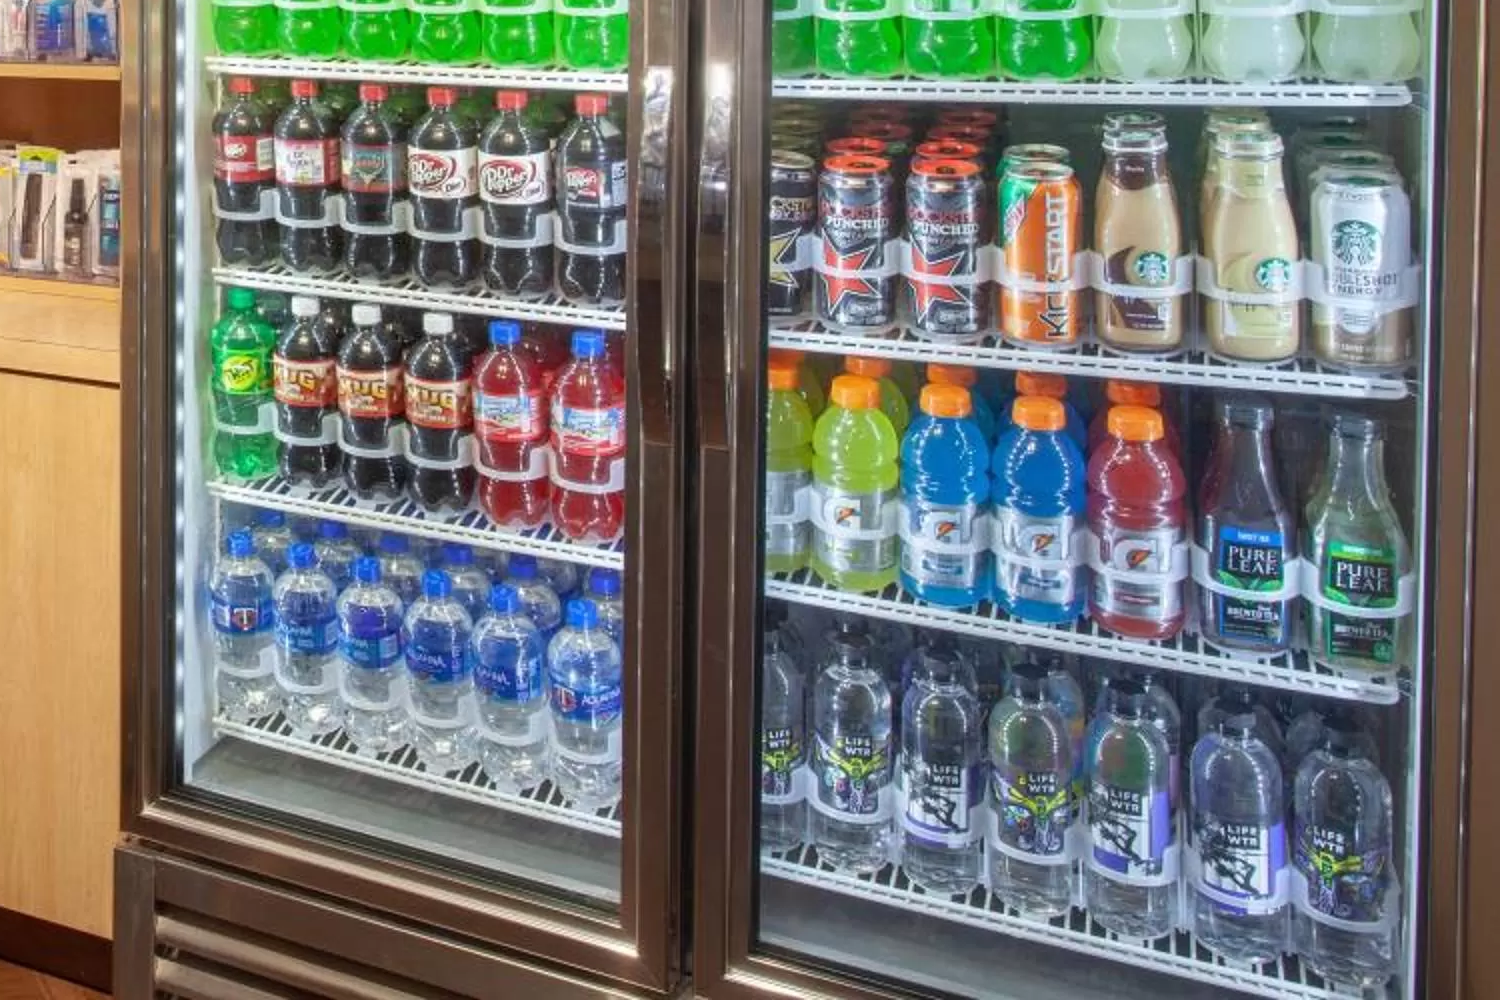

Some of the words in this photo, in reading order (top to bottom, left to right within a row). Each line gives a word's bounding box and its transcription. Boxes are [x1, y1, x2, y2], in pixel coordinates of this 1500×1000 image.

[1039, 191, 1069, 338] KICSTART
[1228, 545, 1278, 562] PURE
[1228, 558, 1278, 576] LEAF
[1337, 561, 1389, 577] PURE
[845, 736, 871, 747] LIFE
[933, 764, 959, 775] LIFE
[1028, 774, 1055, 785] LIFE
[1110, 790, 1140, 802] LIFE
[1111, 801, 1141, 812] WTR
[1227, 824, 1257, 836] LIFE
[1313, 827, 1345, 841] LIFE
[1227, 836, 1258, 846] WTR
[1314, 838, 1345, 853] WTR
